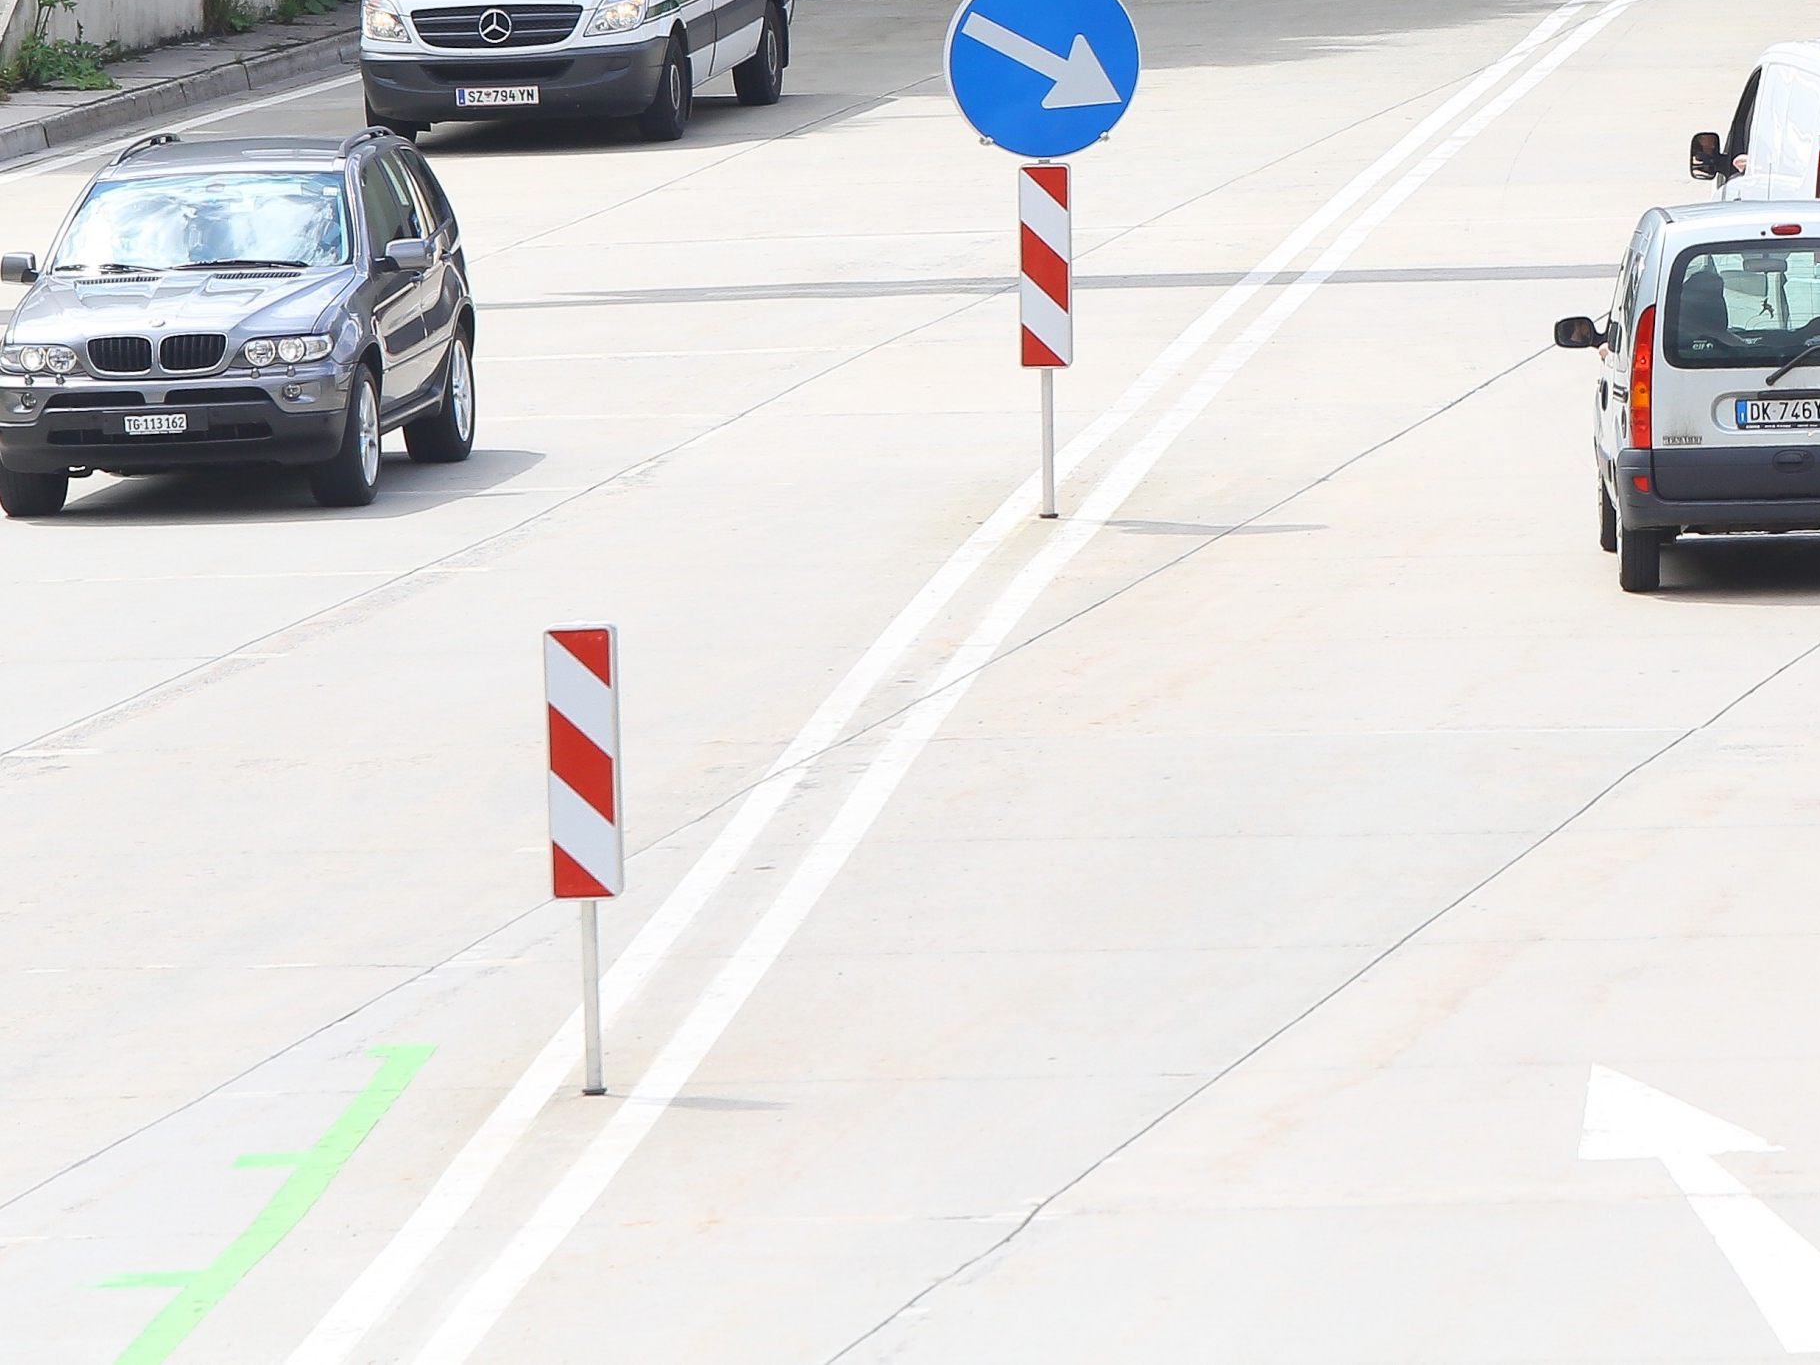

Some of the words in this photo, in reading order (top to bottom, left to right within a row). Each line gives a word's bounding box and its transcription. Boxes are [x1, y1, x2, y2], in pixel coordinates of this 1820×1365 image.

[468, 91, 484, 103] SZ
[492, 90, 516, 103] 794
[518, 89, 535, 102] YN
[1750, 403, 1772, 421] DK
